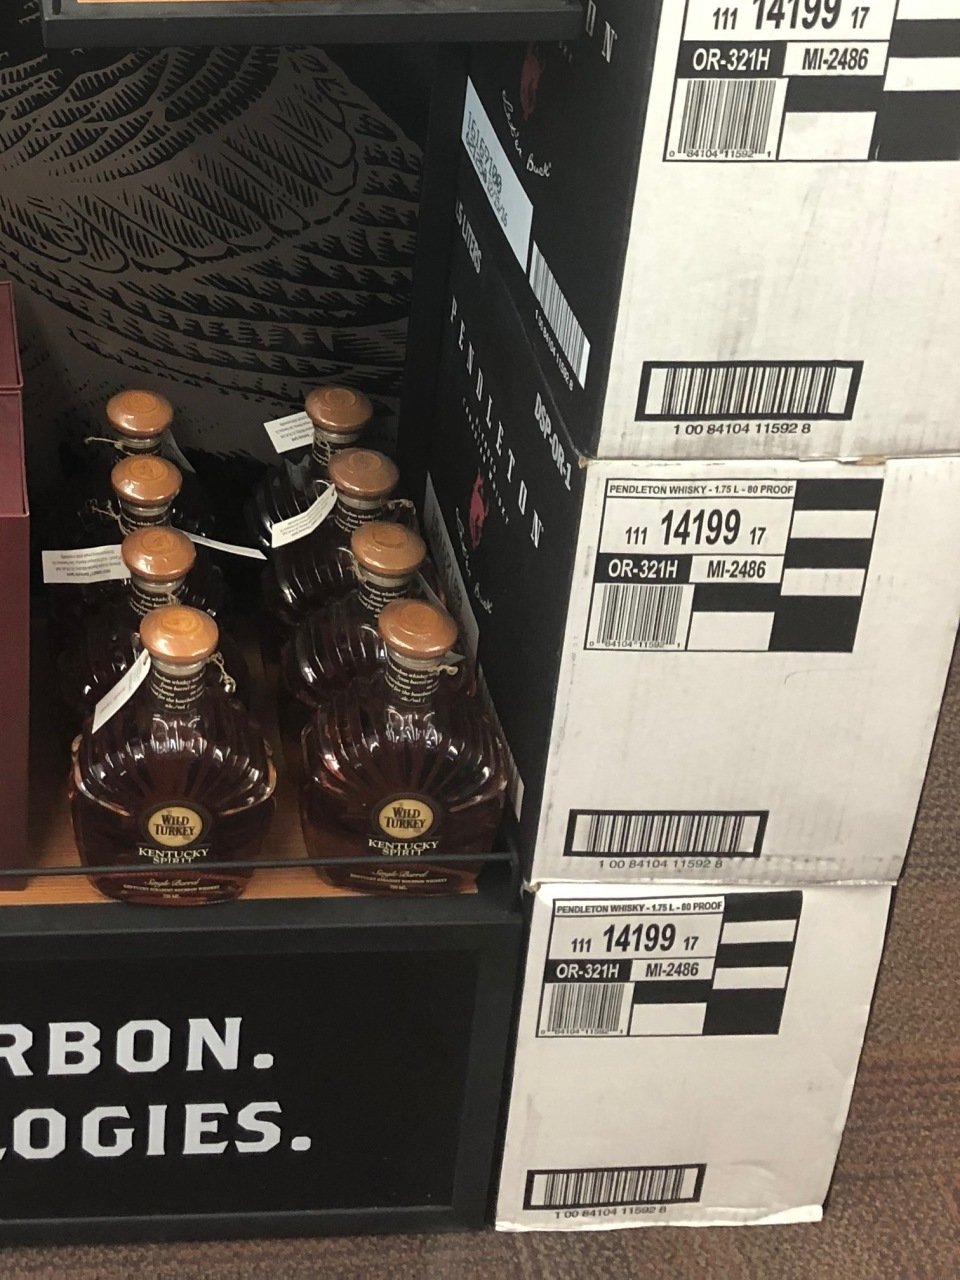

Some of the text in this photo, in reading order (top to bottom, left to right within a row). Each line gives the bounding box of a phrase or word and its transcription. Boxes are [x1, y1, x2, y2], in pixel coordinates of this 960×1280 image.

[712, 7, 738, 30] 111
[851, 6, 870, 29] 17
[693, 48, 869, 70] OR-321H MI-2486
[450, 295, 544, 548] PENDLETON
[685, 423, 798, 435] 00 84104 11592
[534, 392, 572, 491] DSP-OR-1
[609, 485, 667, 494] PENDLETON
[669, 485, 706, 494] WHISKY
[714, 485, 731, 494] 1.75
[760, 484, 793, 494] PROOF
[625, 509, 766, 545] 111 14199 17
[608, 560, 766, 578] OR-321H MI-2486
[392, 807, 420, 818] WILD
[161, 814, 189, 826] WILD
[384, 816, 426, 829] TURKEY
[153, 823, 195, 837] TURKEY
[368, 839, 439, 850] KENTUCKY
[138, 847, 209, 858] KENTUCKY
[382, 848, 424, 856] SPIRIT
[609, 859, 713, 869] 00 84104 11592
[557, 905, 609, 913] PENDLETON
[610, 904, 645, 913] WHISKY
[693, 902, 722, 910] PROOF
[571, 923, 699, 952] 111 14199 17
[556, 963, 699, 979] OR-321H MI-2486
